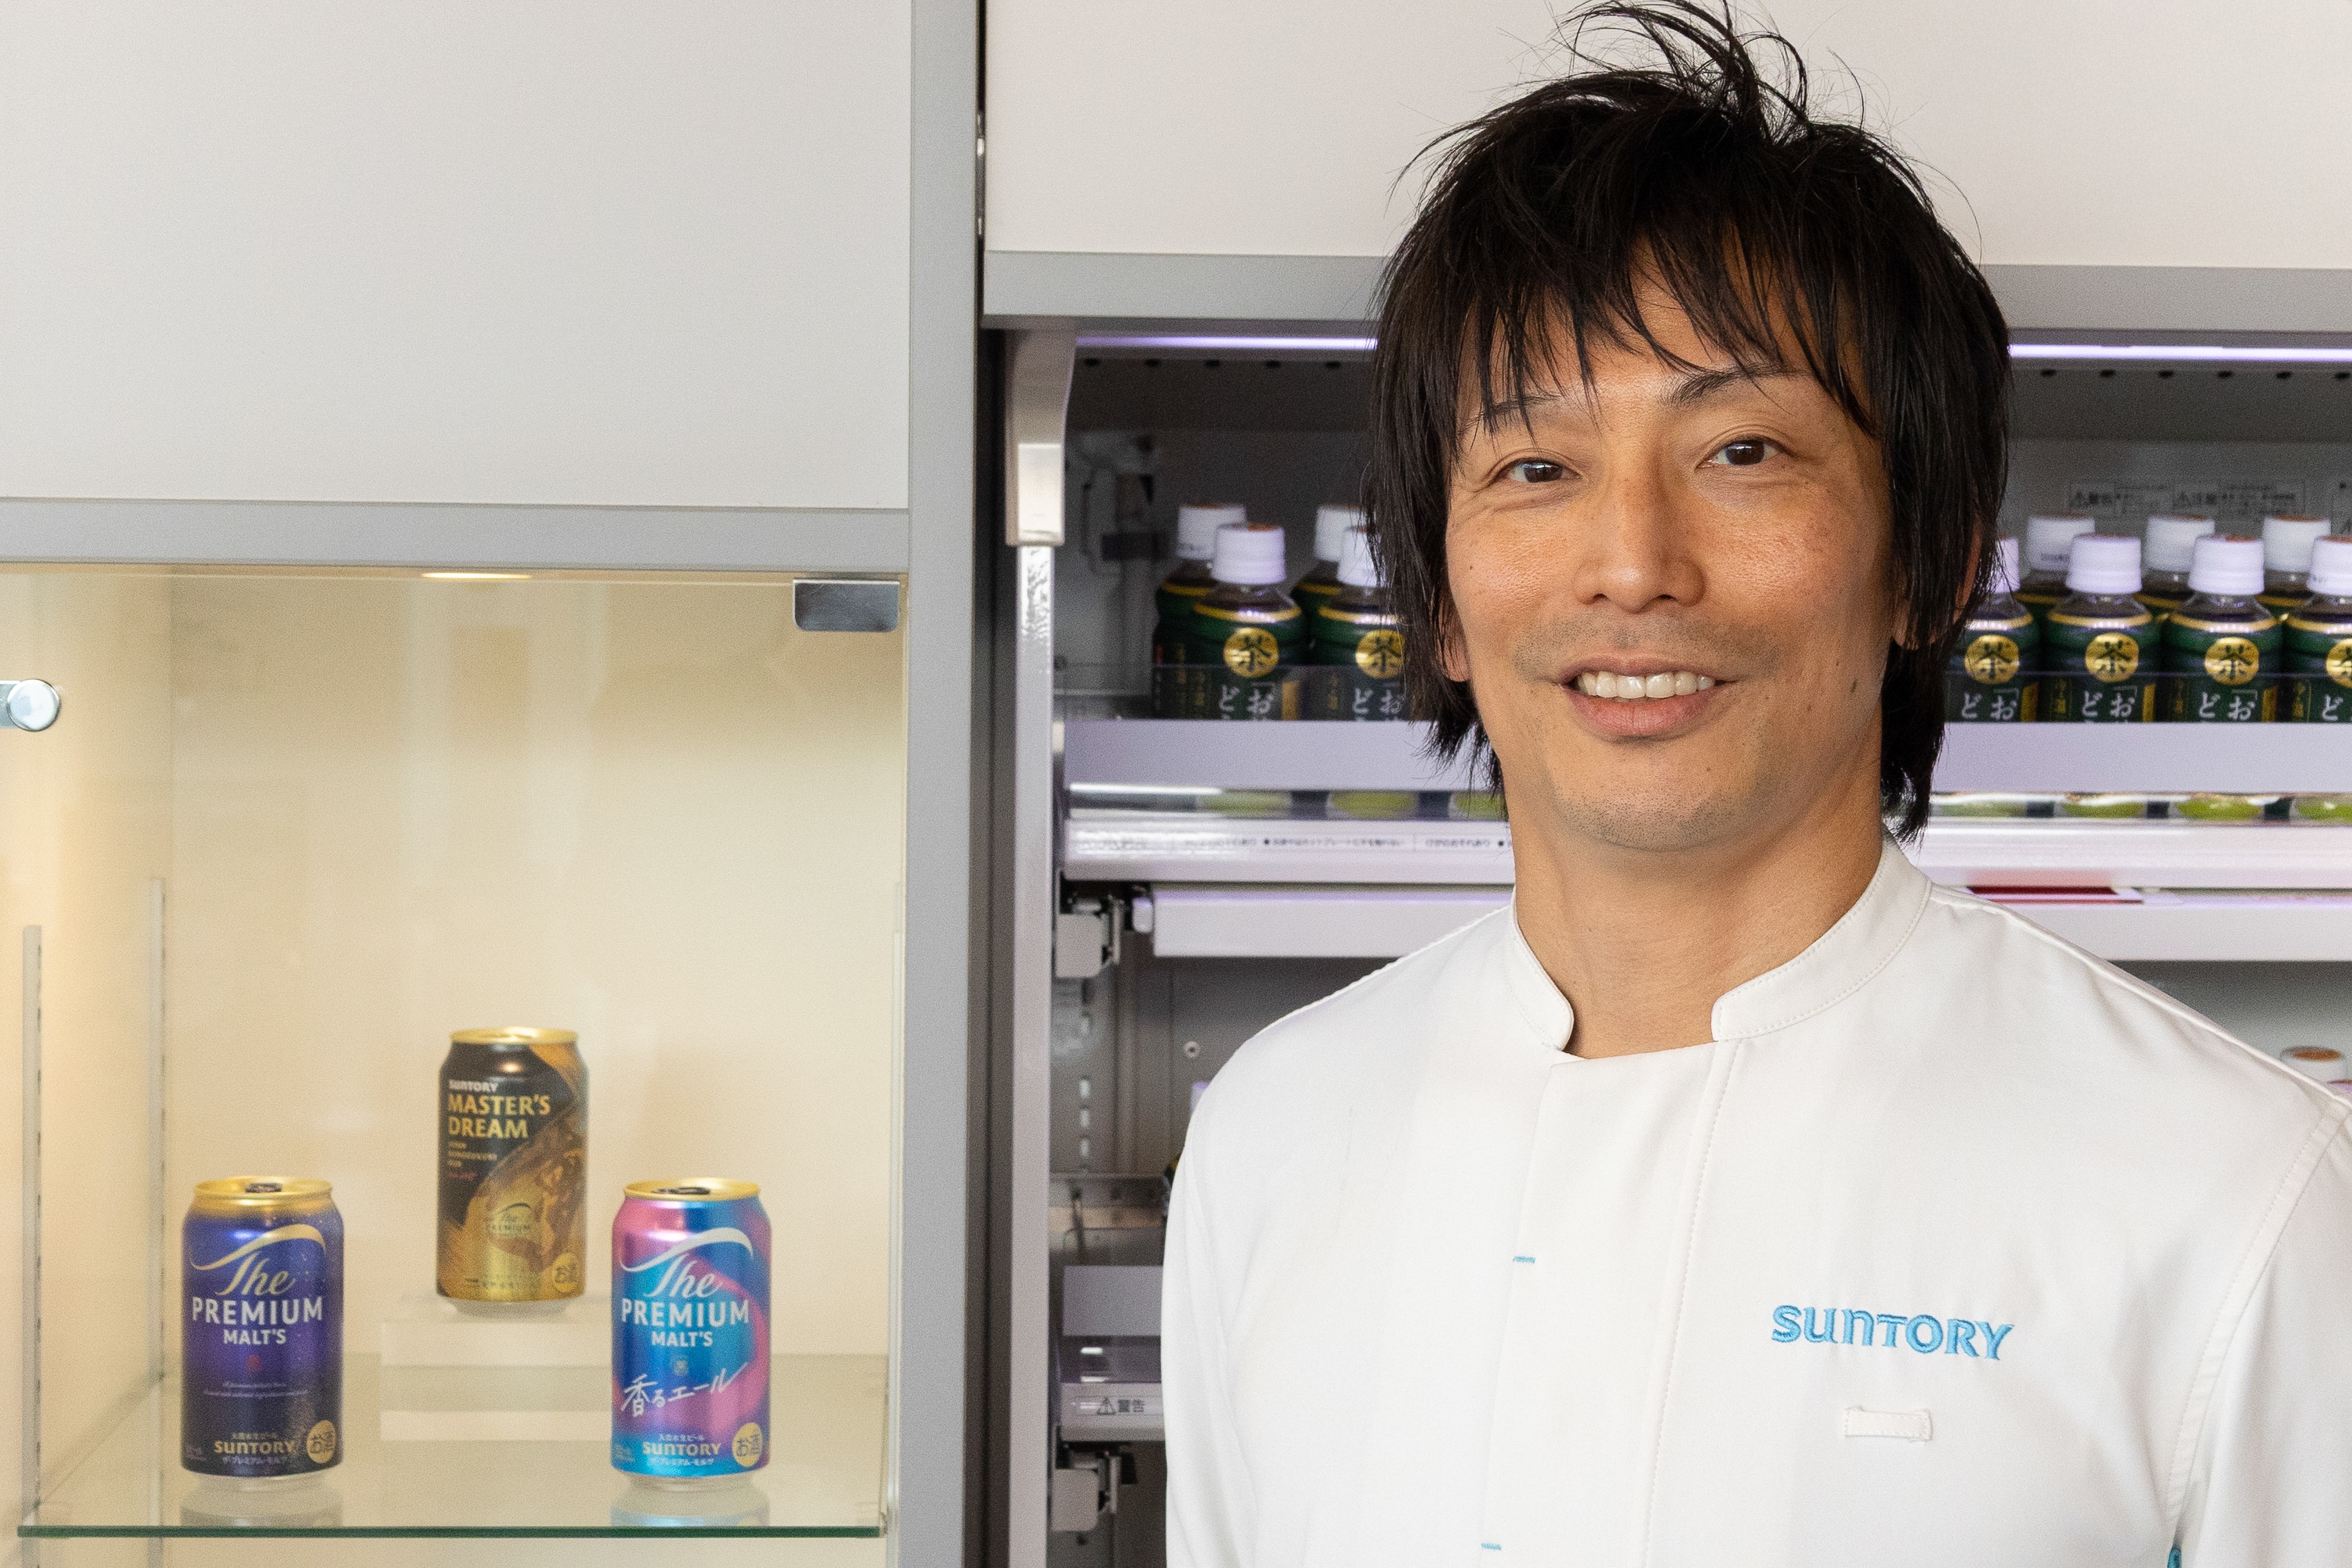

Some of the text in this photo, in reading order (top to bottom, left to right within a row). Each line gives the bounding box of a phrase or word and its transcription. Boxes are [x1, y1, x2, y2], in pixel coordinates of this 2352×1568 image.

[1975, 643, 2011, 680] 茶
[2097, 640, 2131, 677] 茶
[2218, 645, 2252, 680] 茶
[449, 1093, 551, 1116] MASTER'S
[449, 1116, 529, 1138] DREAM
[192, 1296, 323, 1326] PREMIUM
[622, 1297, 749, 1328] PREMIUM
[223, 1328, 286, 1345] MALT'S
[651, 1330, 714, 1348] MALT'S
[1771, 1305, 2015, 1361] SUNTORY
[621, 1362, 748, 1418] 香るエール
[214, 1440, 295, 1455] SUNTORY
[642, 1442, 722, 1456] SUNTORY
